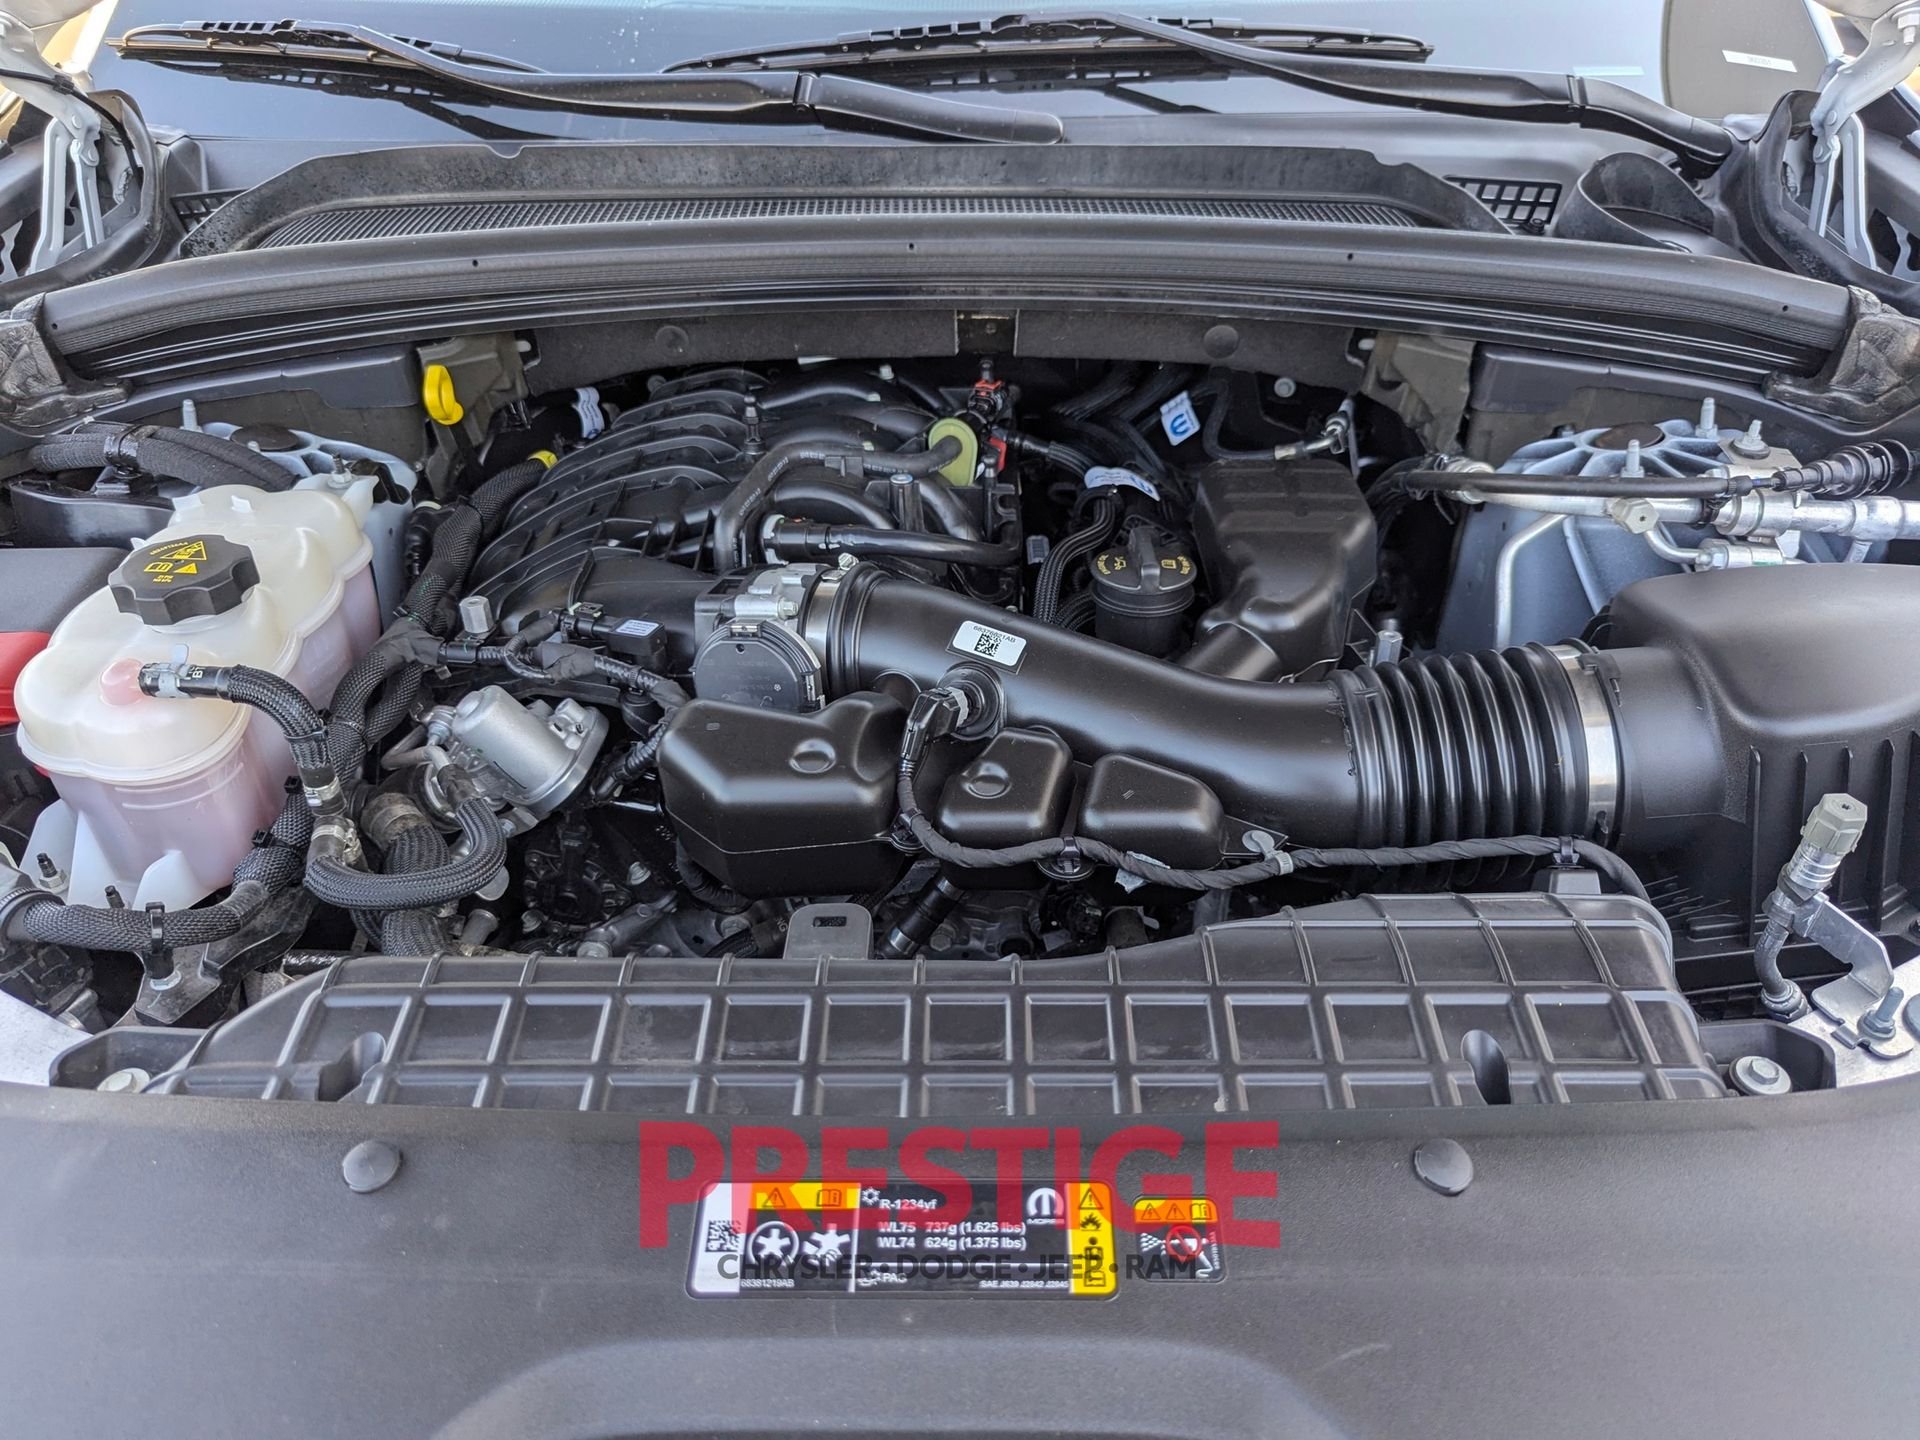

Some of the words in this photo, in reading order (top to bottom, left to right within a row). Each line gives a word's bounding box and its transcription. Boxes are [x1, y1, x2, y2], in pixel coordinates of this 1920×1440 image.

[879, 1199, 937, 1213] R-1234yf
[878, 1221, 916, 1233] WL75
[925, 1221, 957, 1235] 737g
[959, 1221, 998, 1235] (1.625
[1000, 1221, 1027, 1235] lbs)
[877, 1236, 916, 1248] WL74
[924, 1236, 957, 1250] 624g
[959, 1236, 998, 1250] (1.375
[1000, 1236, 1027, 1250] lbs)
